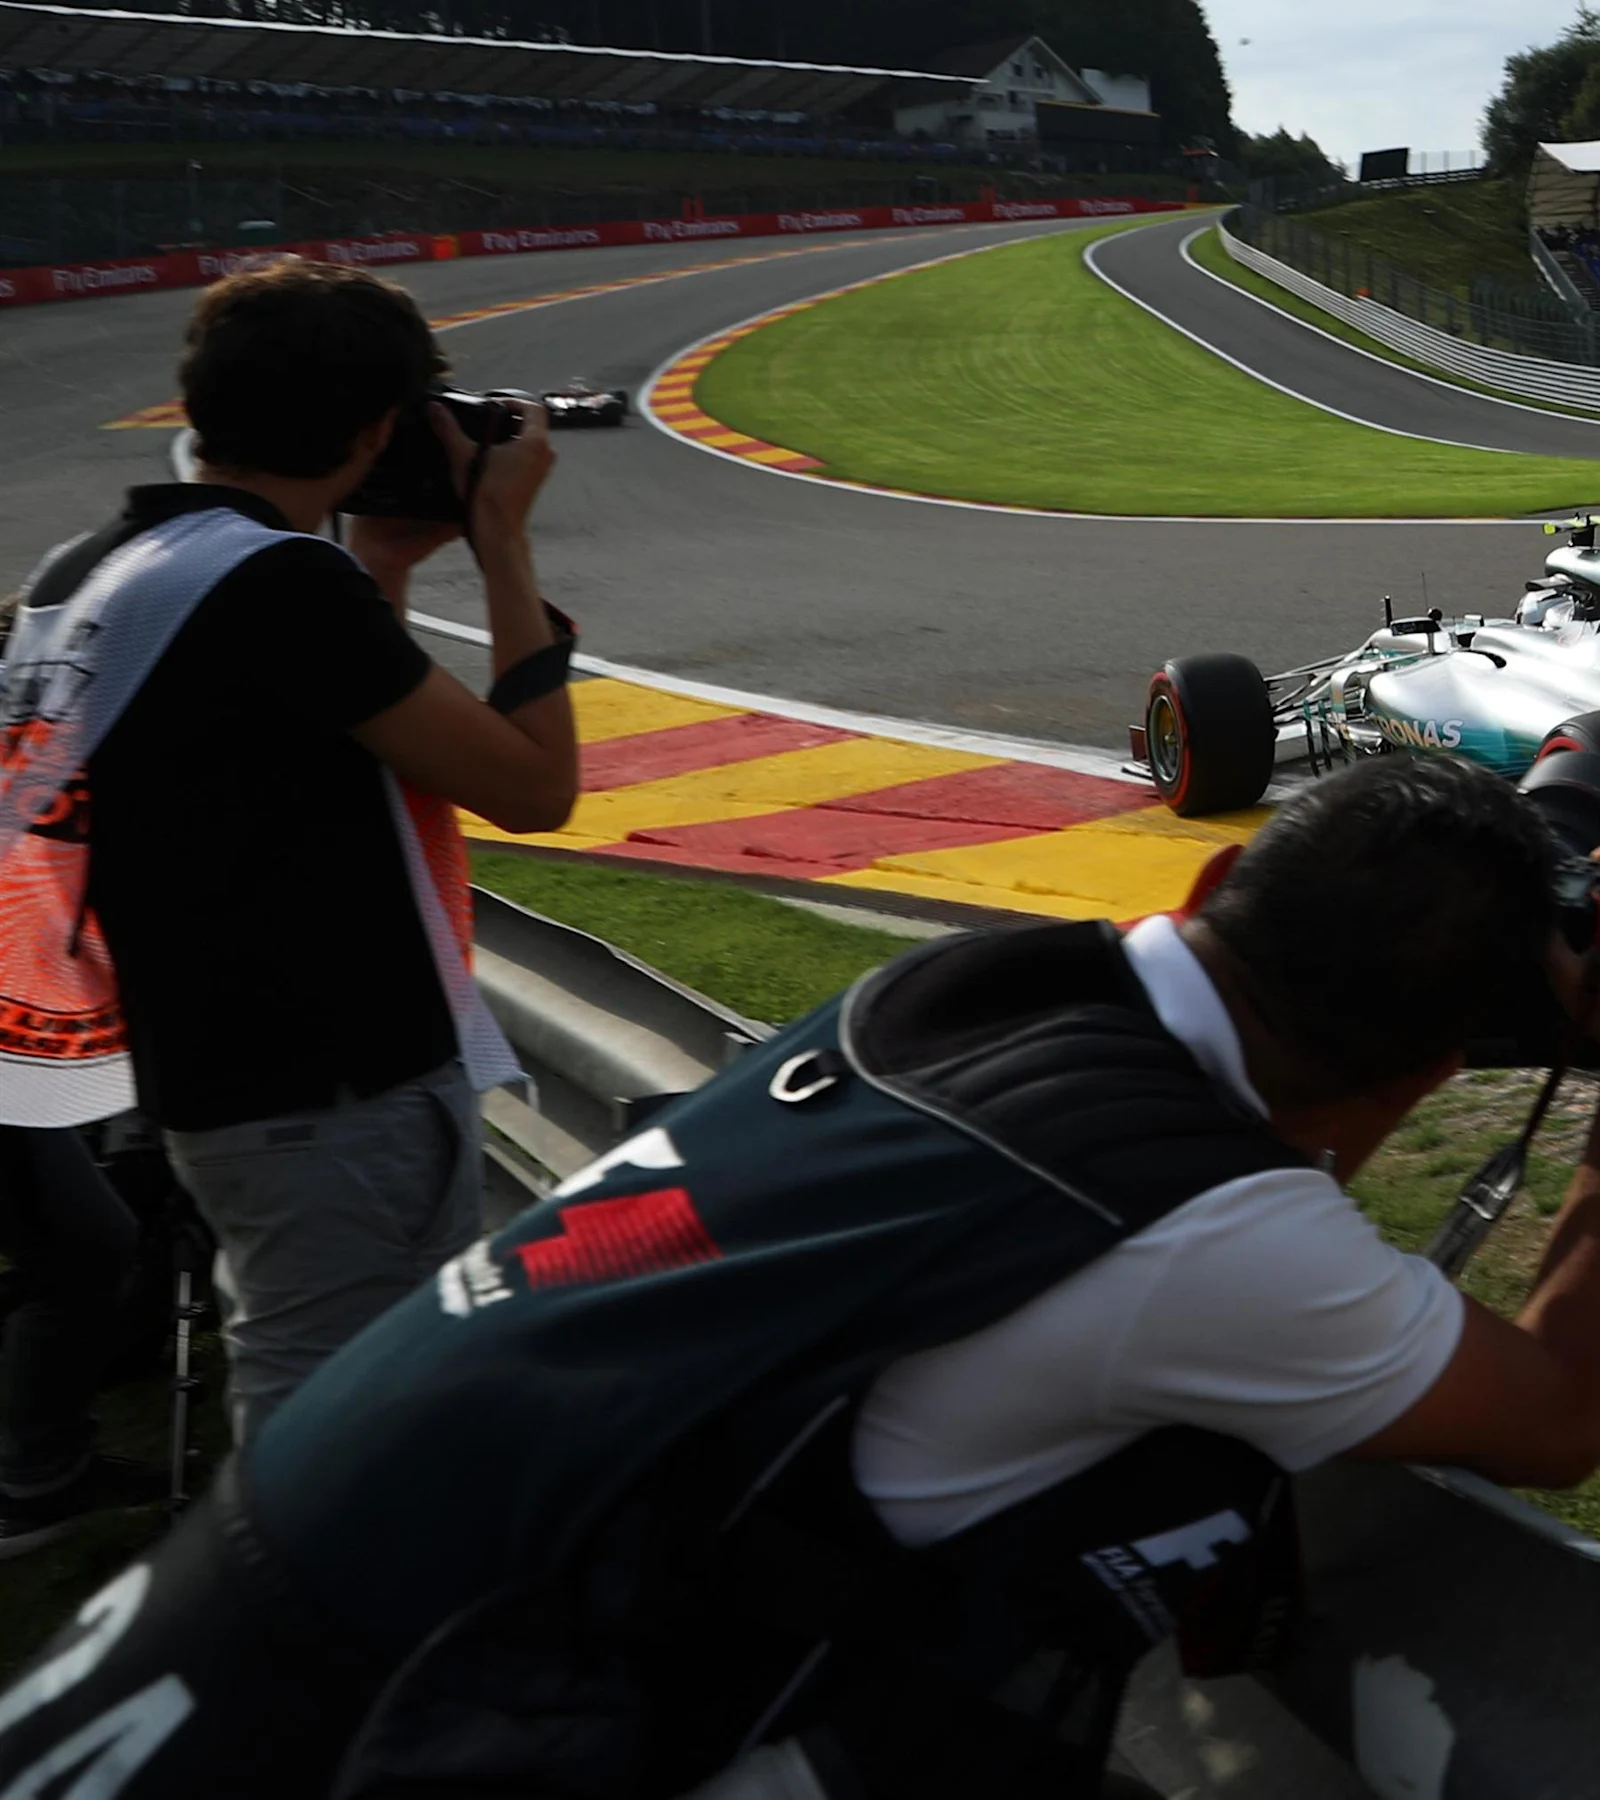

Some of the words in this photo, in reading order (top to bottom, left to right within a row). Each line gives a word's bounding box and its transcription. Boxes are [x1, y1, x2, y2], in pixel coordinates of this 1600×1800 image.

[482, 233, 517, 251] Fly
[516, 229, 599, 247] Emirates
[644, 222, 672, 240] Fly
[671, 219, 739, 236] Emirates
[83, 265, 157, 287] Emirates
